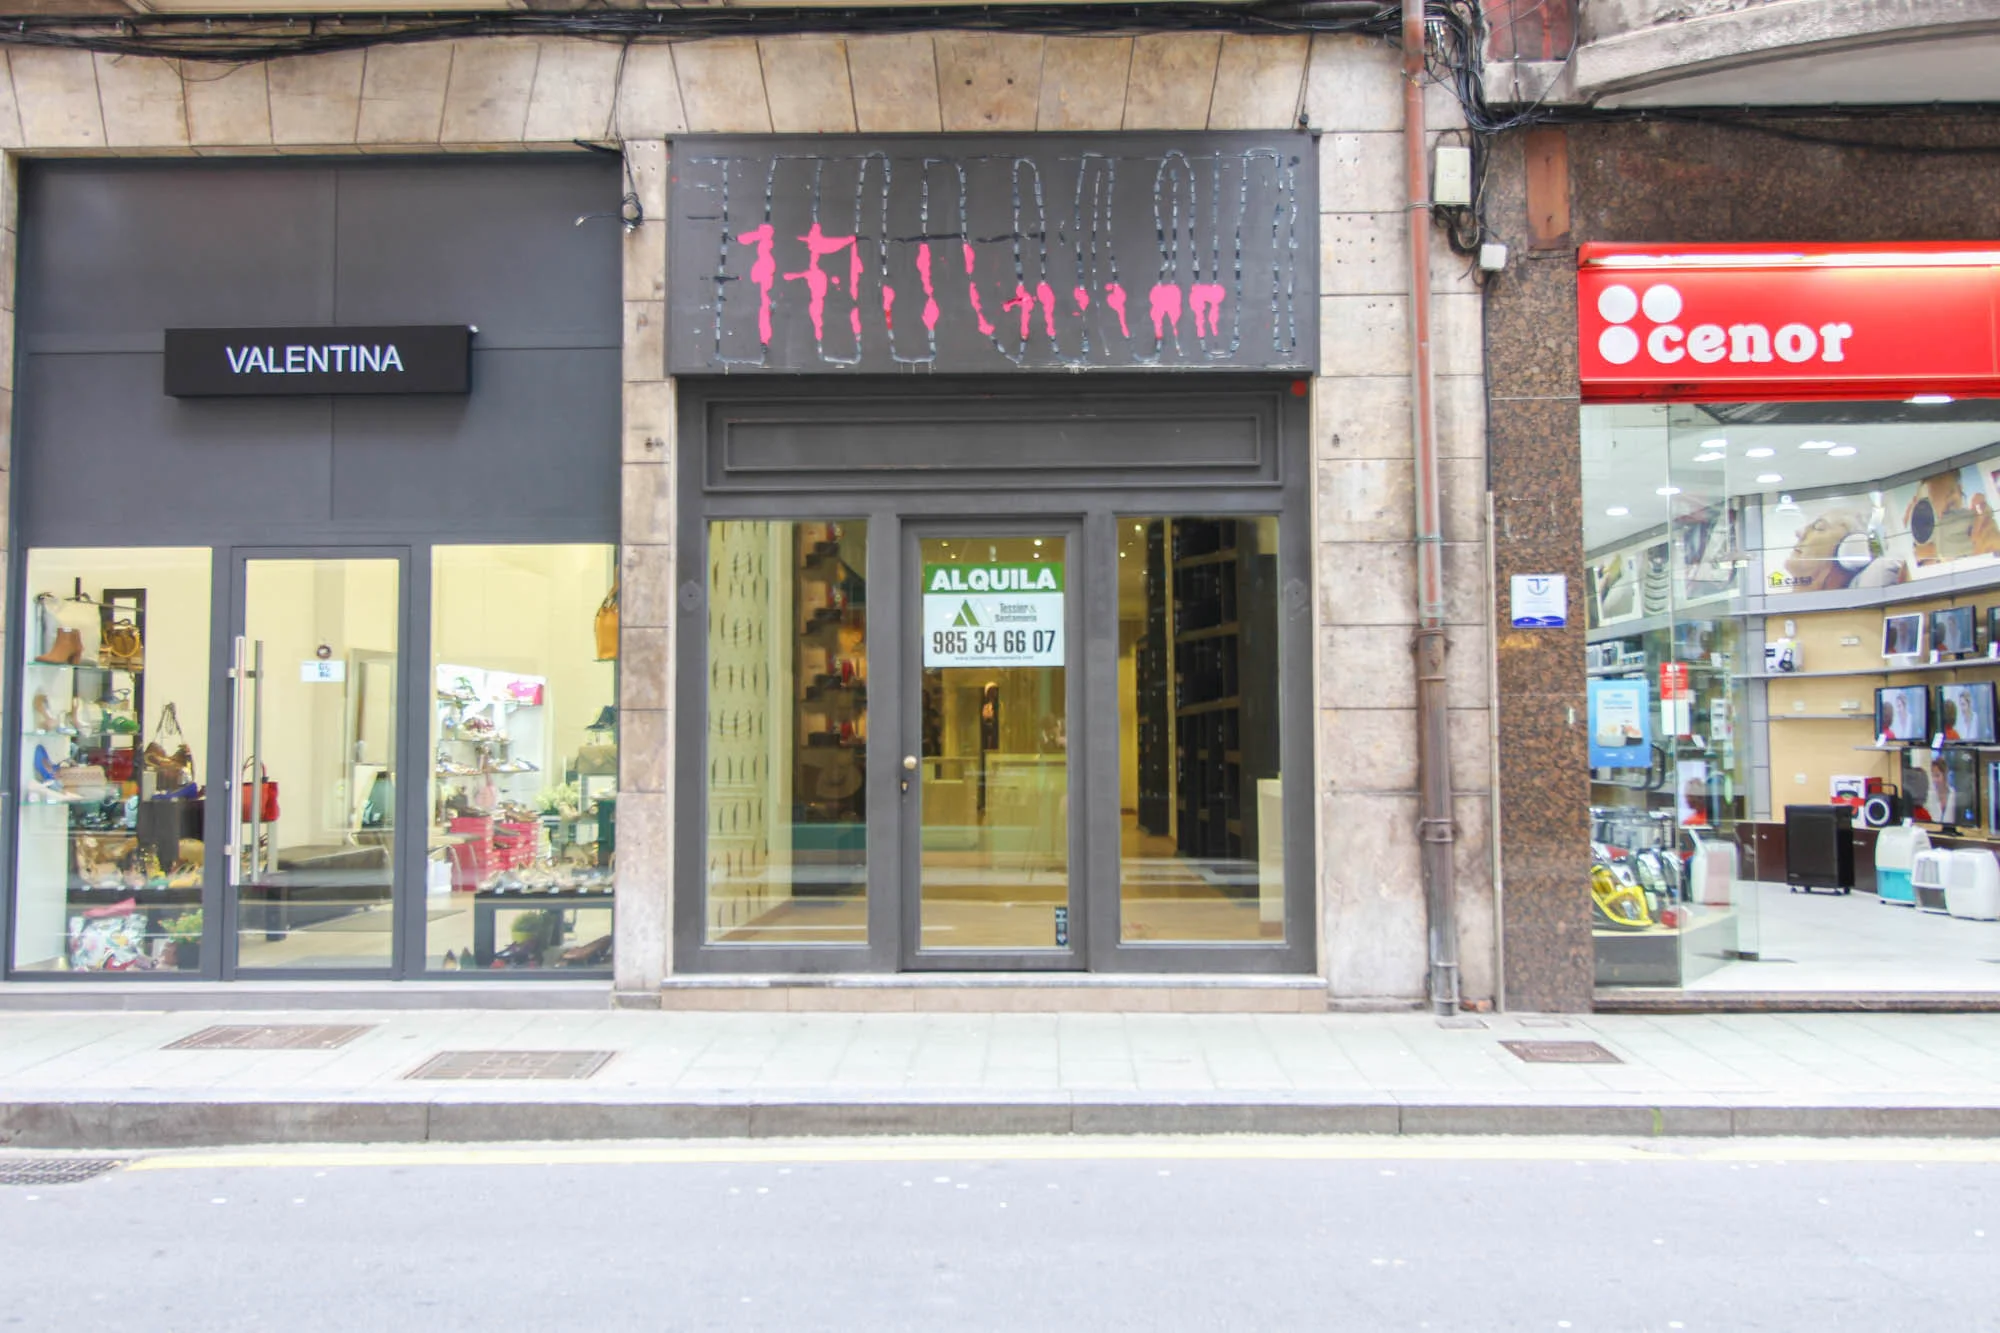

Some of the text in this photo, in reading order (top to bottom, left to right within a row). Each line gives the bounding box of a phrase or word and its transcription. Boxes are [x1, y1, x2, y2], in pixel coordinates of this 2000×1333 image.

[1647, 321, 1853, 364] cenor
[226, 344, 404, 373] VALENTINA
[930, 568, 1056, 591] ALQUILA
[933, 630, 1055, 654] 985 34 66 07
